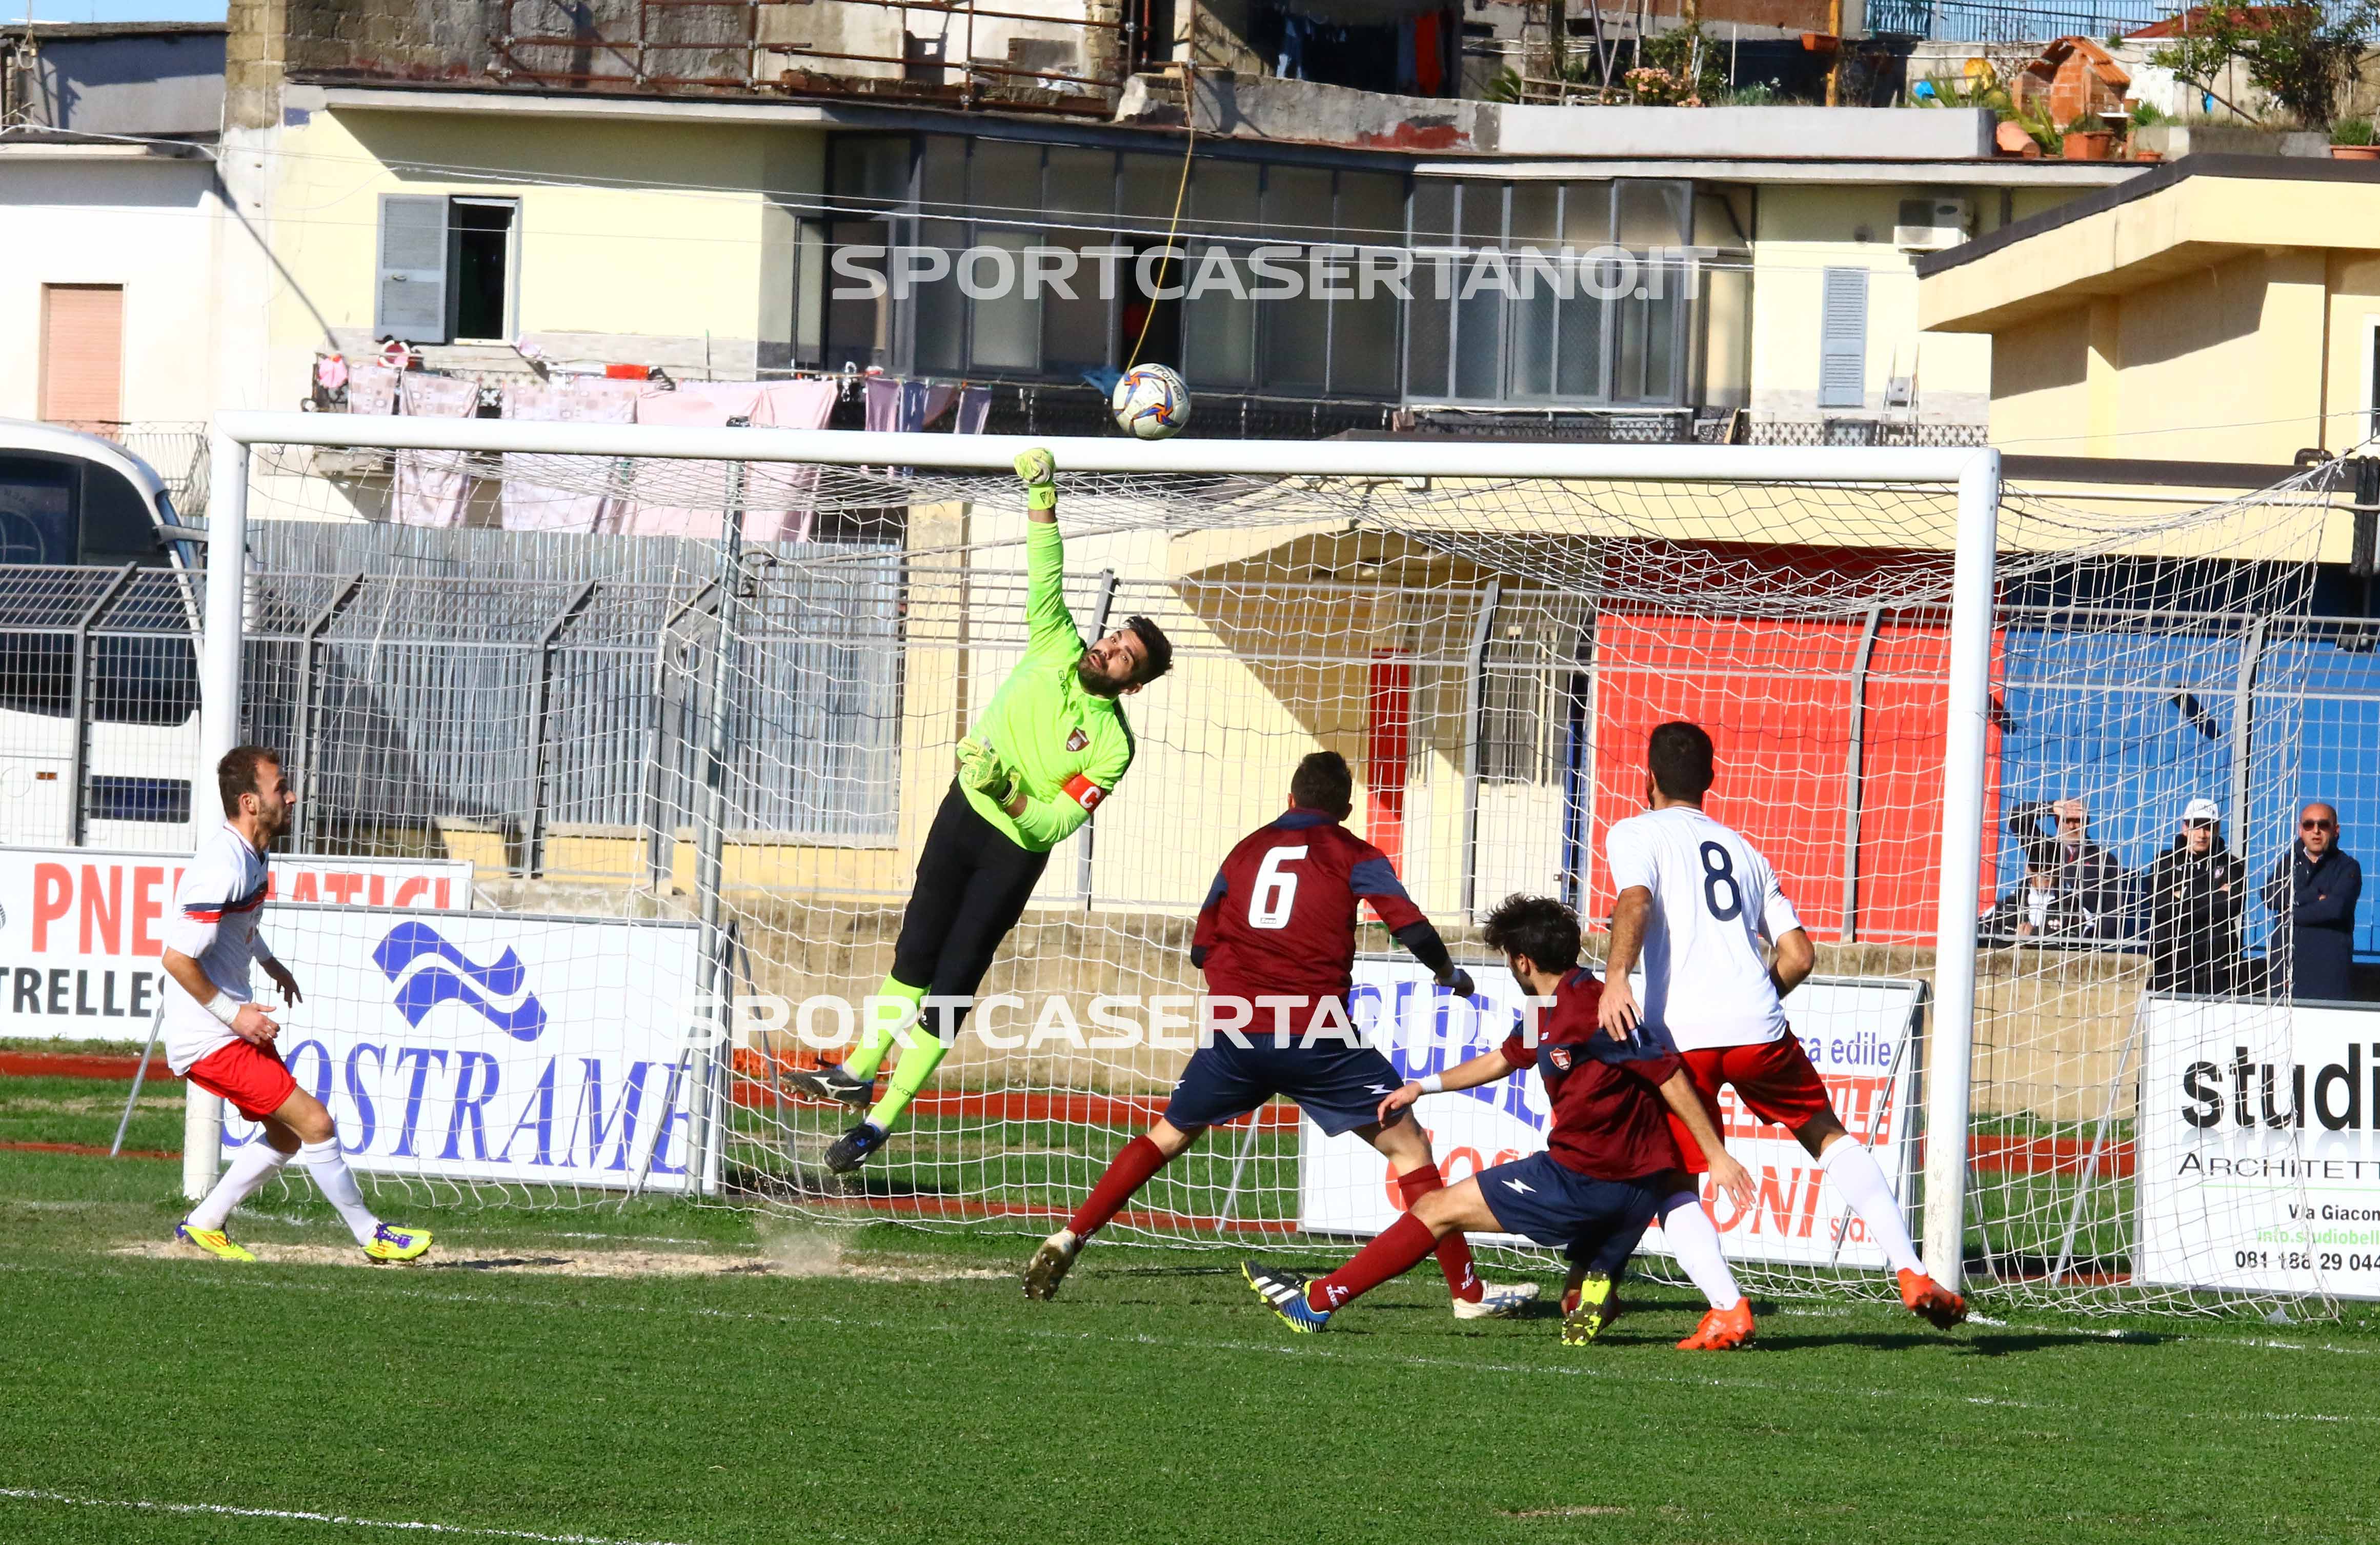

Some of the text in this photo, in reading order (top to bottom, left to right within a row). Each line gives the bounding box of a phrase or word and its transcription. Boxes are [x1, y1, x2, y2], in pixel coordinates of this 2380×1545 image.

[1079, 786, 1101, 809] C
[1248, 845, 1308, 929] 6
[1700, 840, 1742, 921] 8
[1831, 1031, 1891, 1067] edile
[2235, 1251, 2267, 1269] 081
[2320, 1253, 2342, 1271] 29
